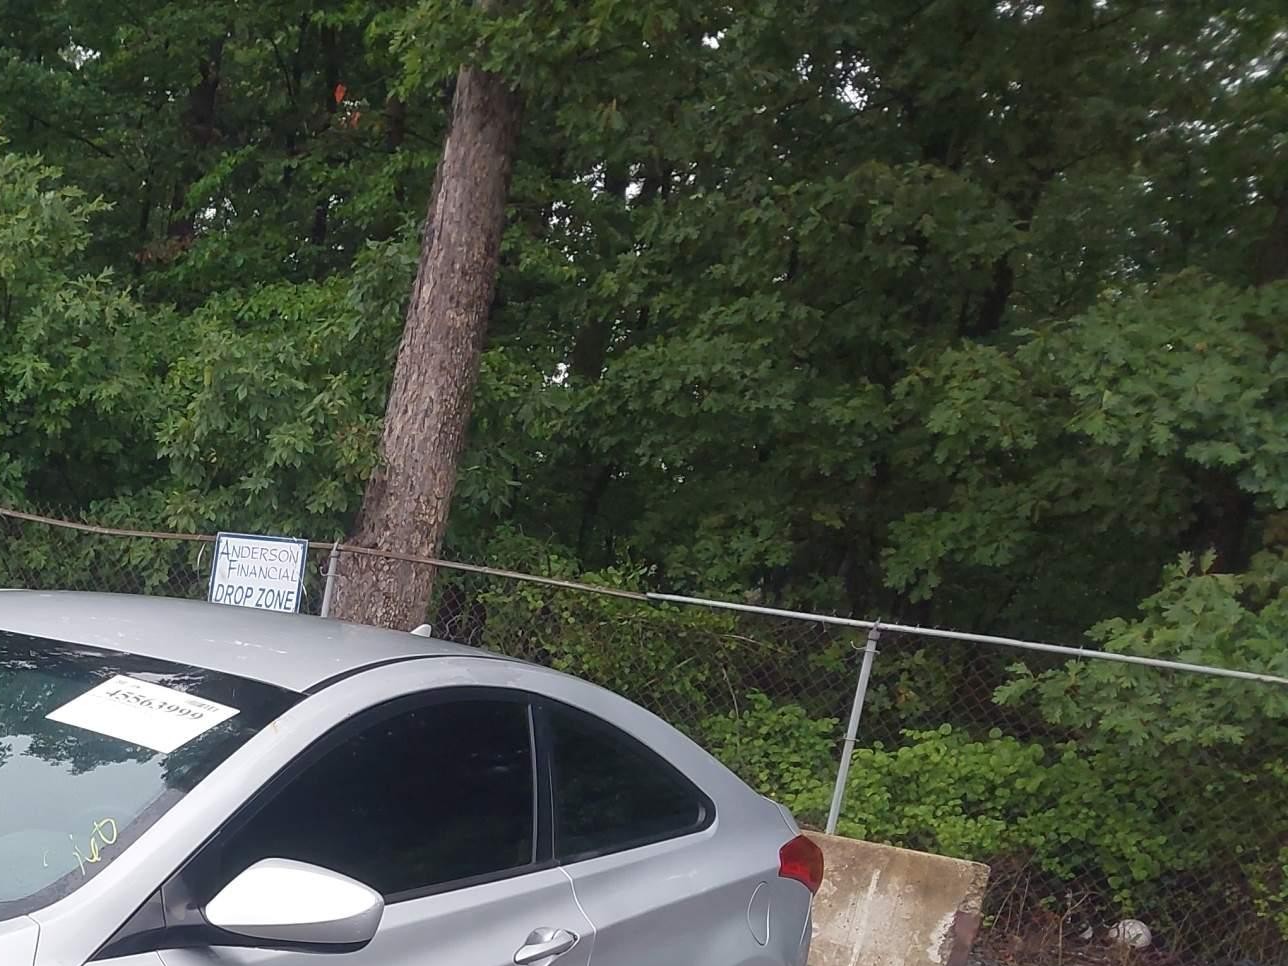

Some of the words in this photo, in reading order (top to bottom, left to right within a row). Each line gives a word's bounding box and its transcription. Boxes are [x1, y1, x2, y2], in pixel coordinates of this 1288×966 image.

[219, 539, 299, 564] ANDERSON
[227, 559, 296, 582] FINANCIAL
[214, 583, 253, 605] DROP
[255, 588, 294, 610] ZONE
[106, 689, 204, 720] 45563999
